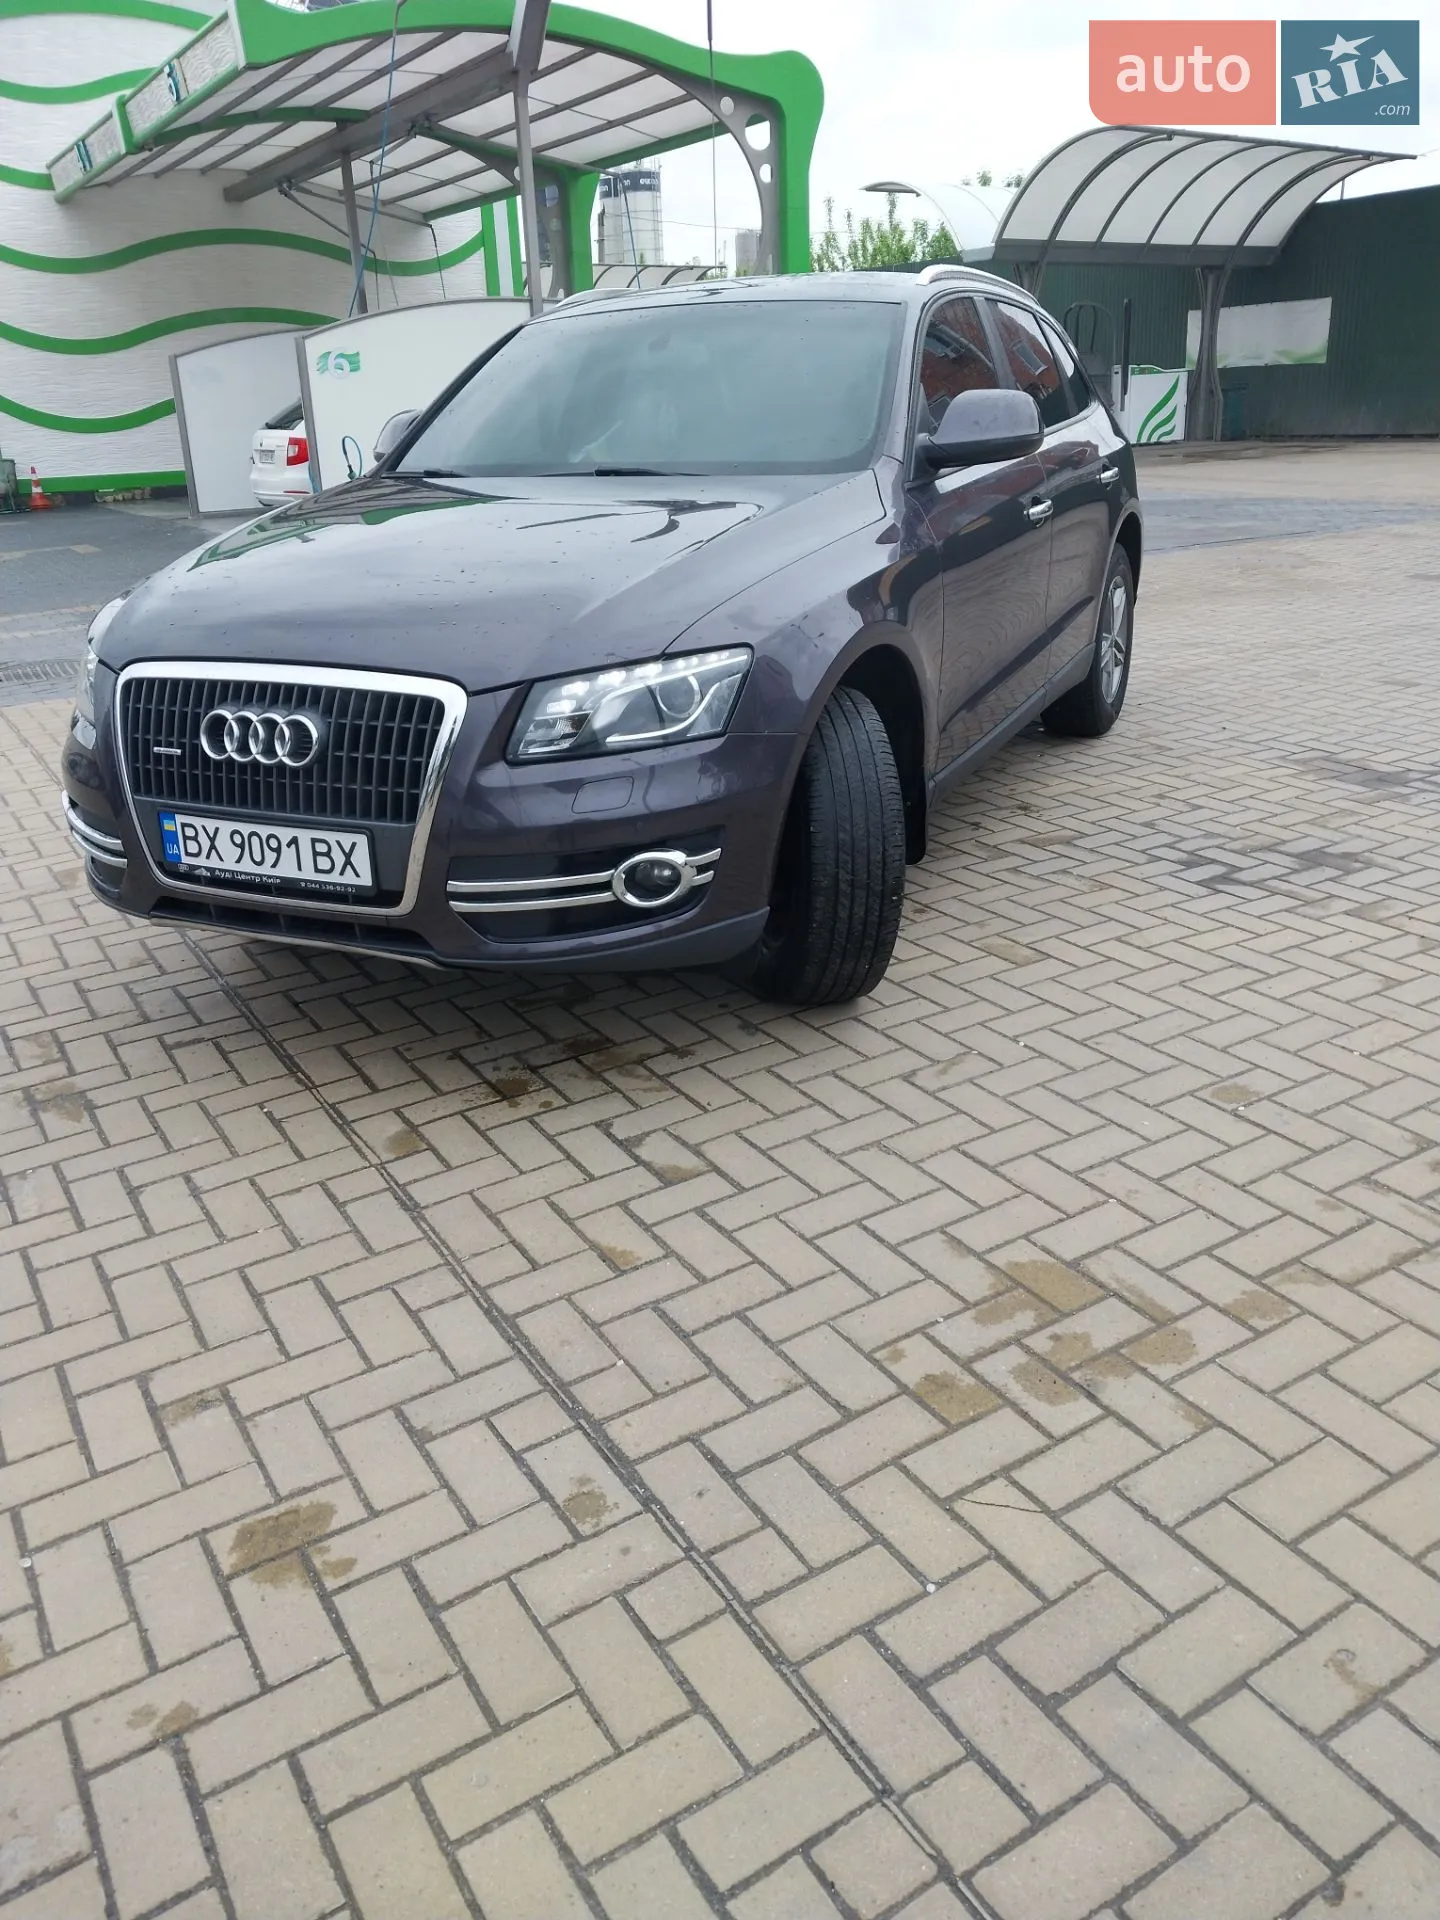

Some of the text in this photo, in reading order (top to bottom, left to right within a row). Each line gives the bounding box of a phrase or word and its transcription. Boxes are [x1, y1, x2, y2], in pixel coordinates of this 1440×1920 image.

[327, 348, 350, 379] 6
[166, 843, 180, 856] UA
[180, 822, 361, 878] BX 9091 BX
[233, 871, 261, 883] Центр
